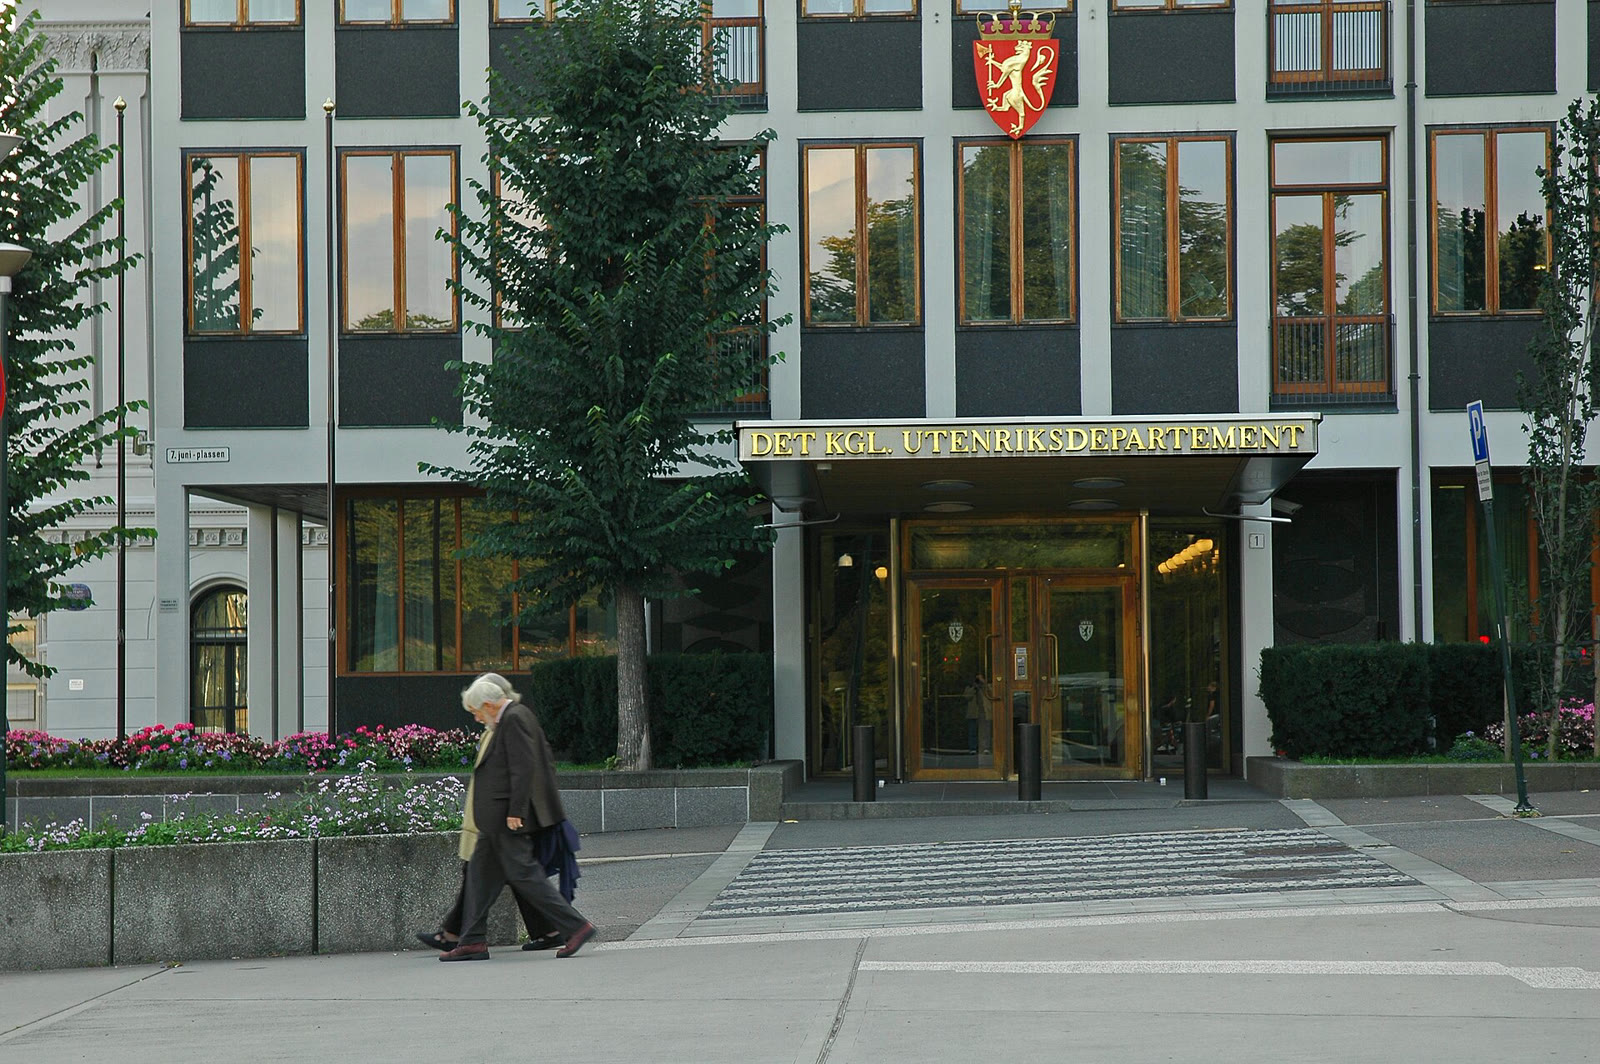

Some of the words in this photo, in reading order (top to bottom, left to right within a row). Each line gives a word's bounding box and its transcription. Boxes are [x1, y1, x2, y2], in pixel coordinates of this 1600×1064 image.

[751, 431, 815, 456] DET
[825, 430, 893, 455] KGL.
[902, 425, 1305, 455] UTENRIKSDEPARTEMENT
[1471, 409, 1481, 455] P
